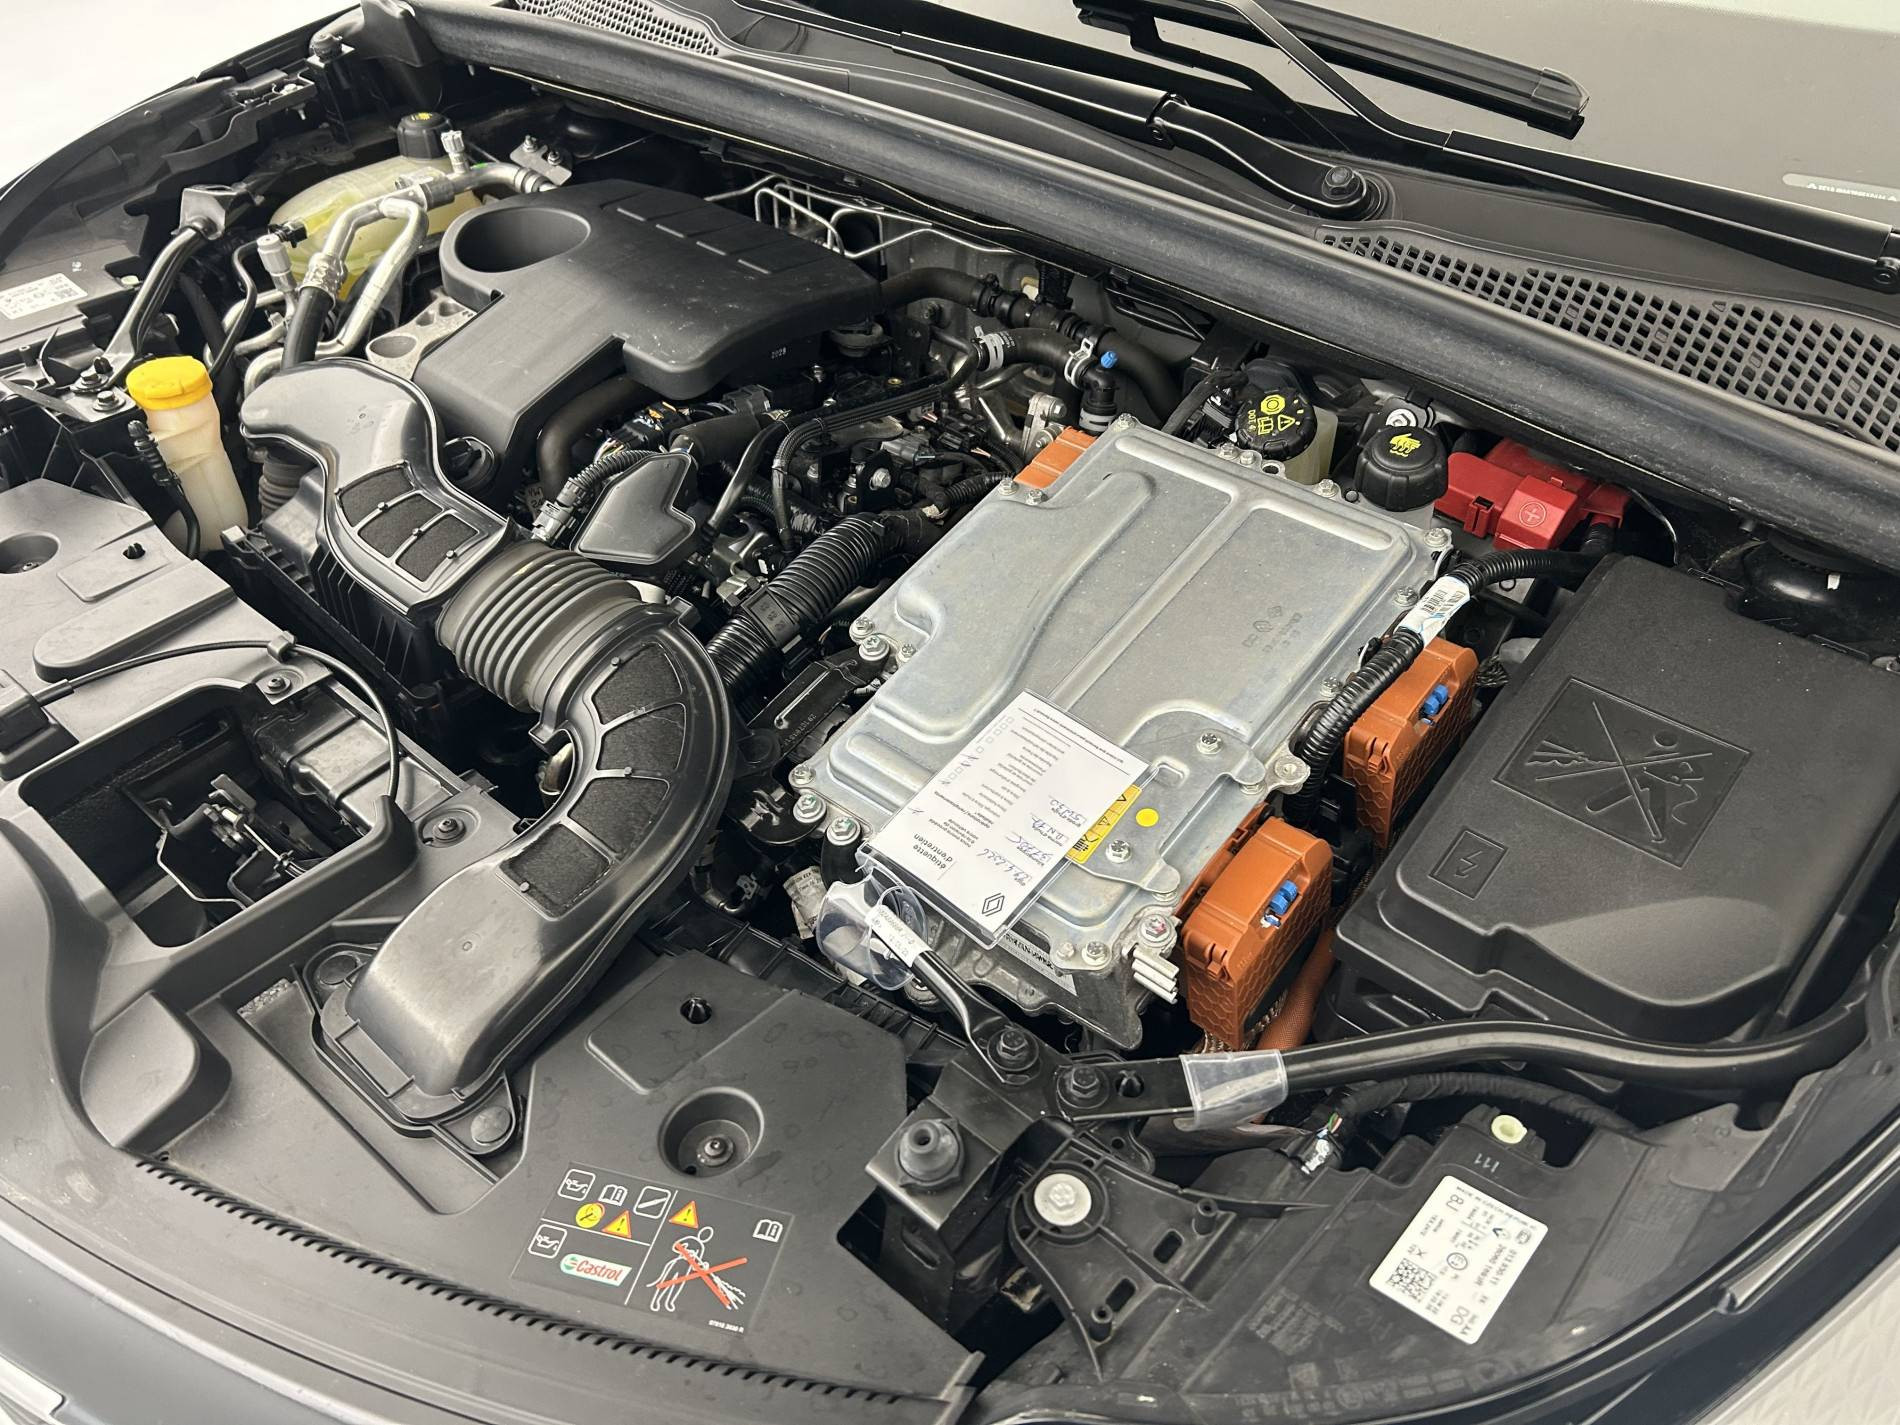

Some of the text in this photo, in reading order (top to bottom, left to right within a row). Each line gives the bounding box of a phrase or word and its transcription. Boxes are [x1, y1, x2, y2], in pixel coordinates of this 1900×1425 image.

[914, 834, 953, 862] d'entretien
[1445, 1194, 1464, 1212] 8J
[576, 1260, 623, 1281] Castrol
[1450, 1306, 1470, 1325] DG
